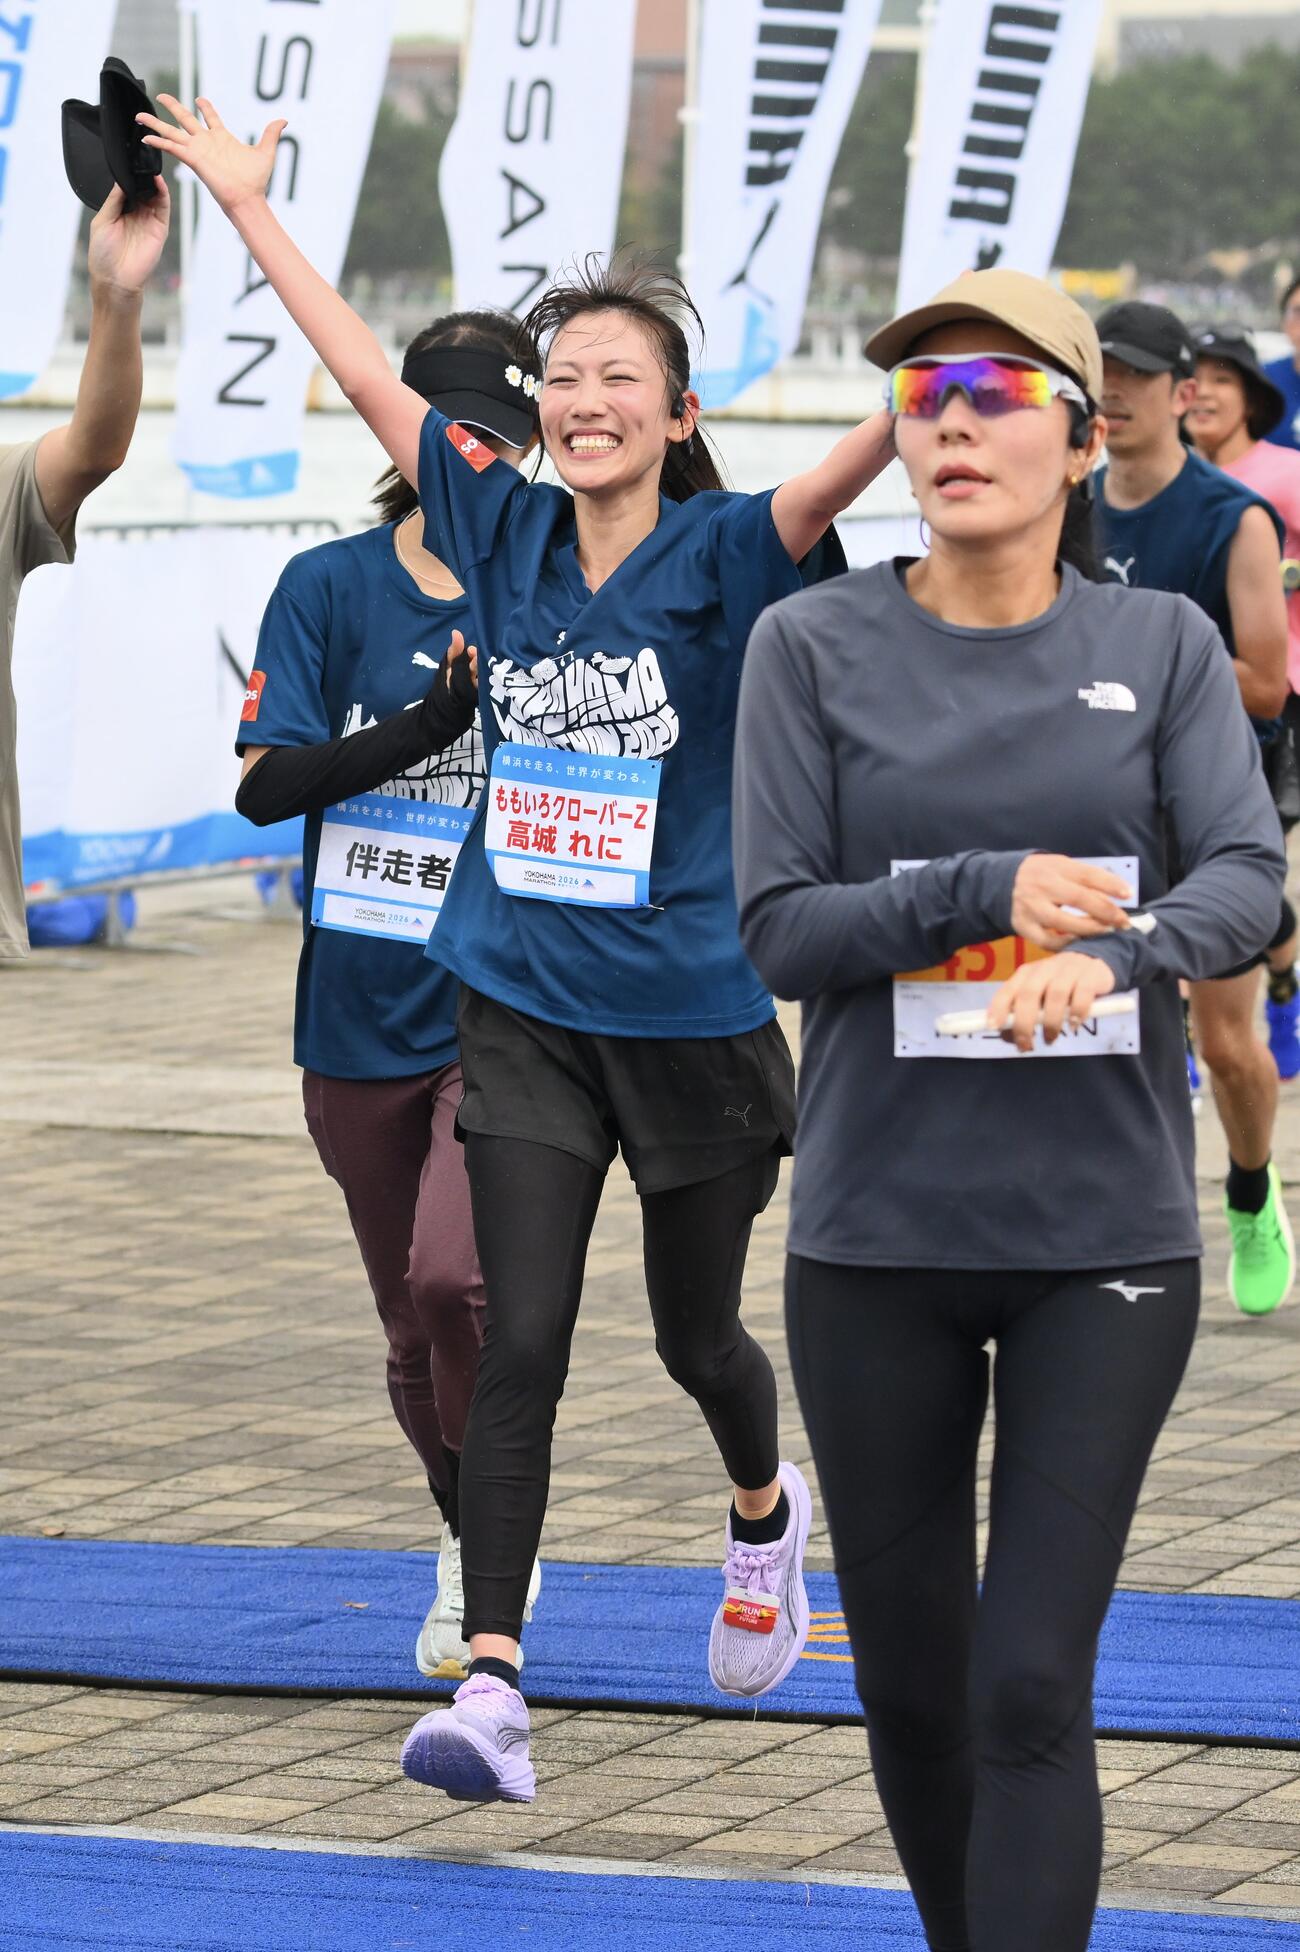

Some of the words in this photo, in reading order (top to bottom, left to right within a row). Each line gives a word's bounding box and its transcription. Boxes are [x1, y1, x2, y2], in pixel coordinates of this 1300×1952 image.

[502, 755, 647, 784] 横浜を走る、世界が変わる。
[496, 785, 648, 829] ももいろクローバーZ
[507, 820, 557, 855] 高城
[568, 830, 623, 861] れに
[346, 842, 452, 891] 伴走者
[524, 870, 556, 881] YOKOHAMA
[558, 875, 579, 885] 2026
[524, 877, 556, 887] MARATHON
[354, 915, 386, 924] MARATHON
[355, 908, 386, 918] YOKOHAMA
[388, 914, 409, 923] 2026
[741, 1605, 760, 1617] RUN
